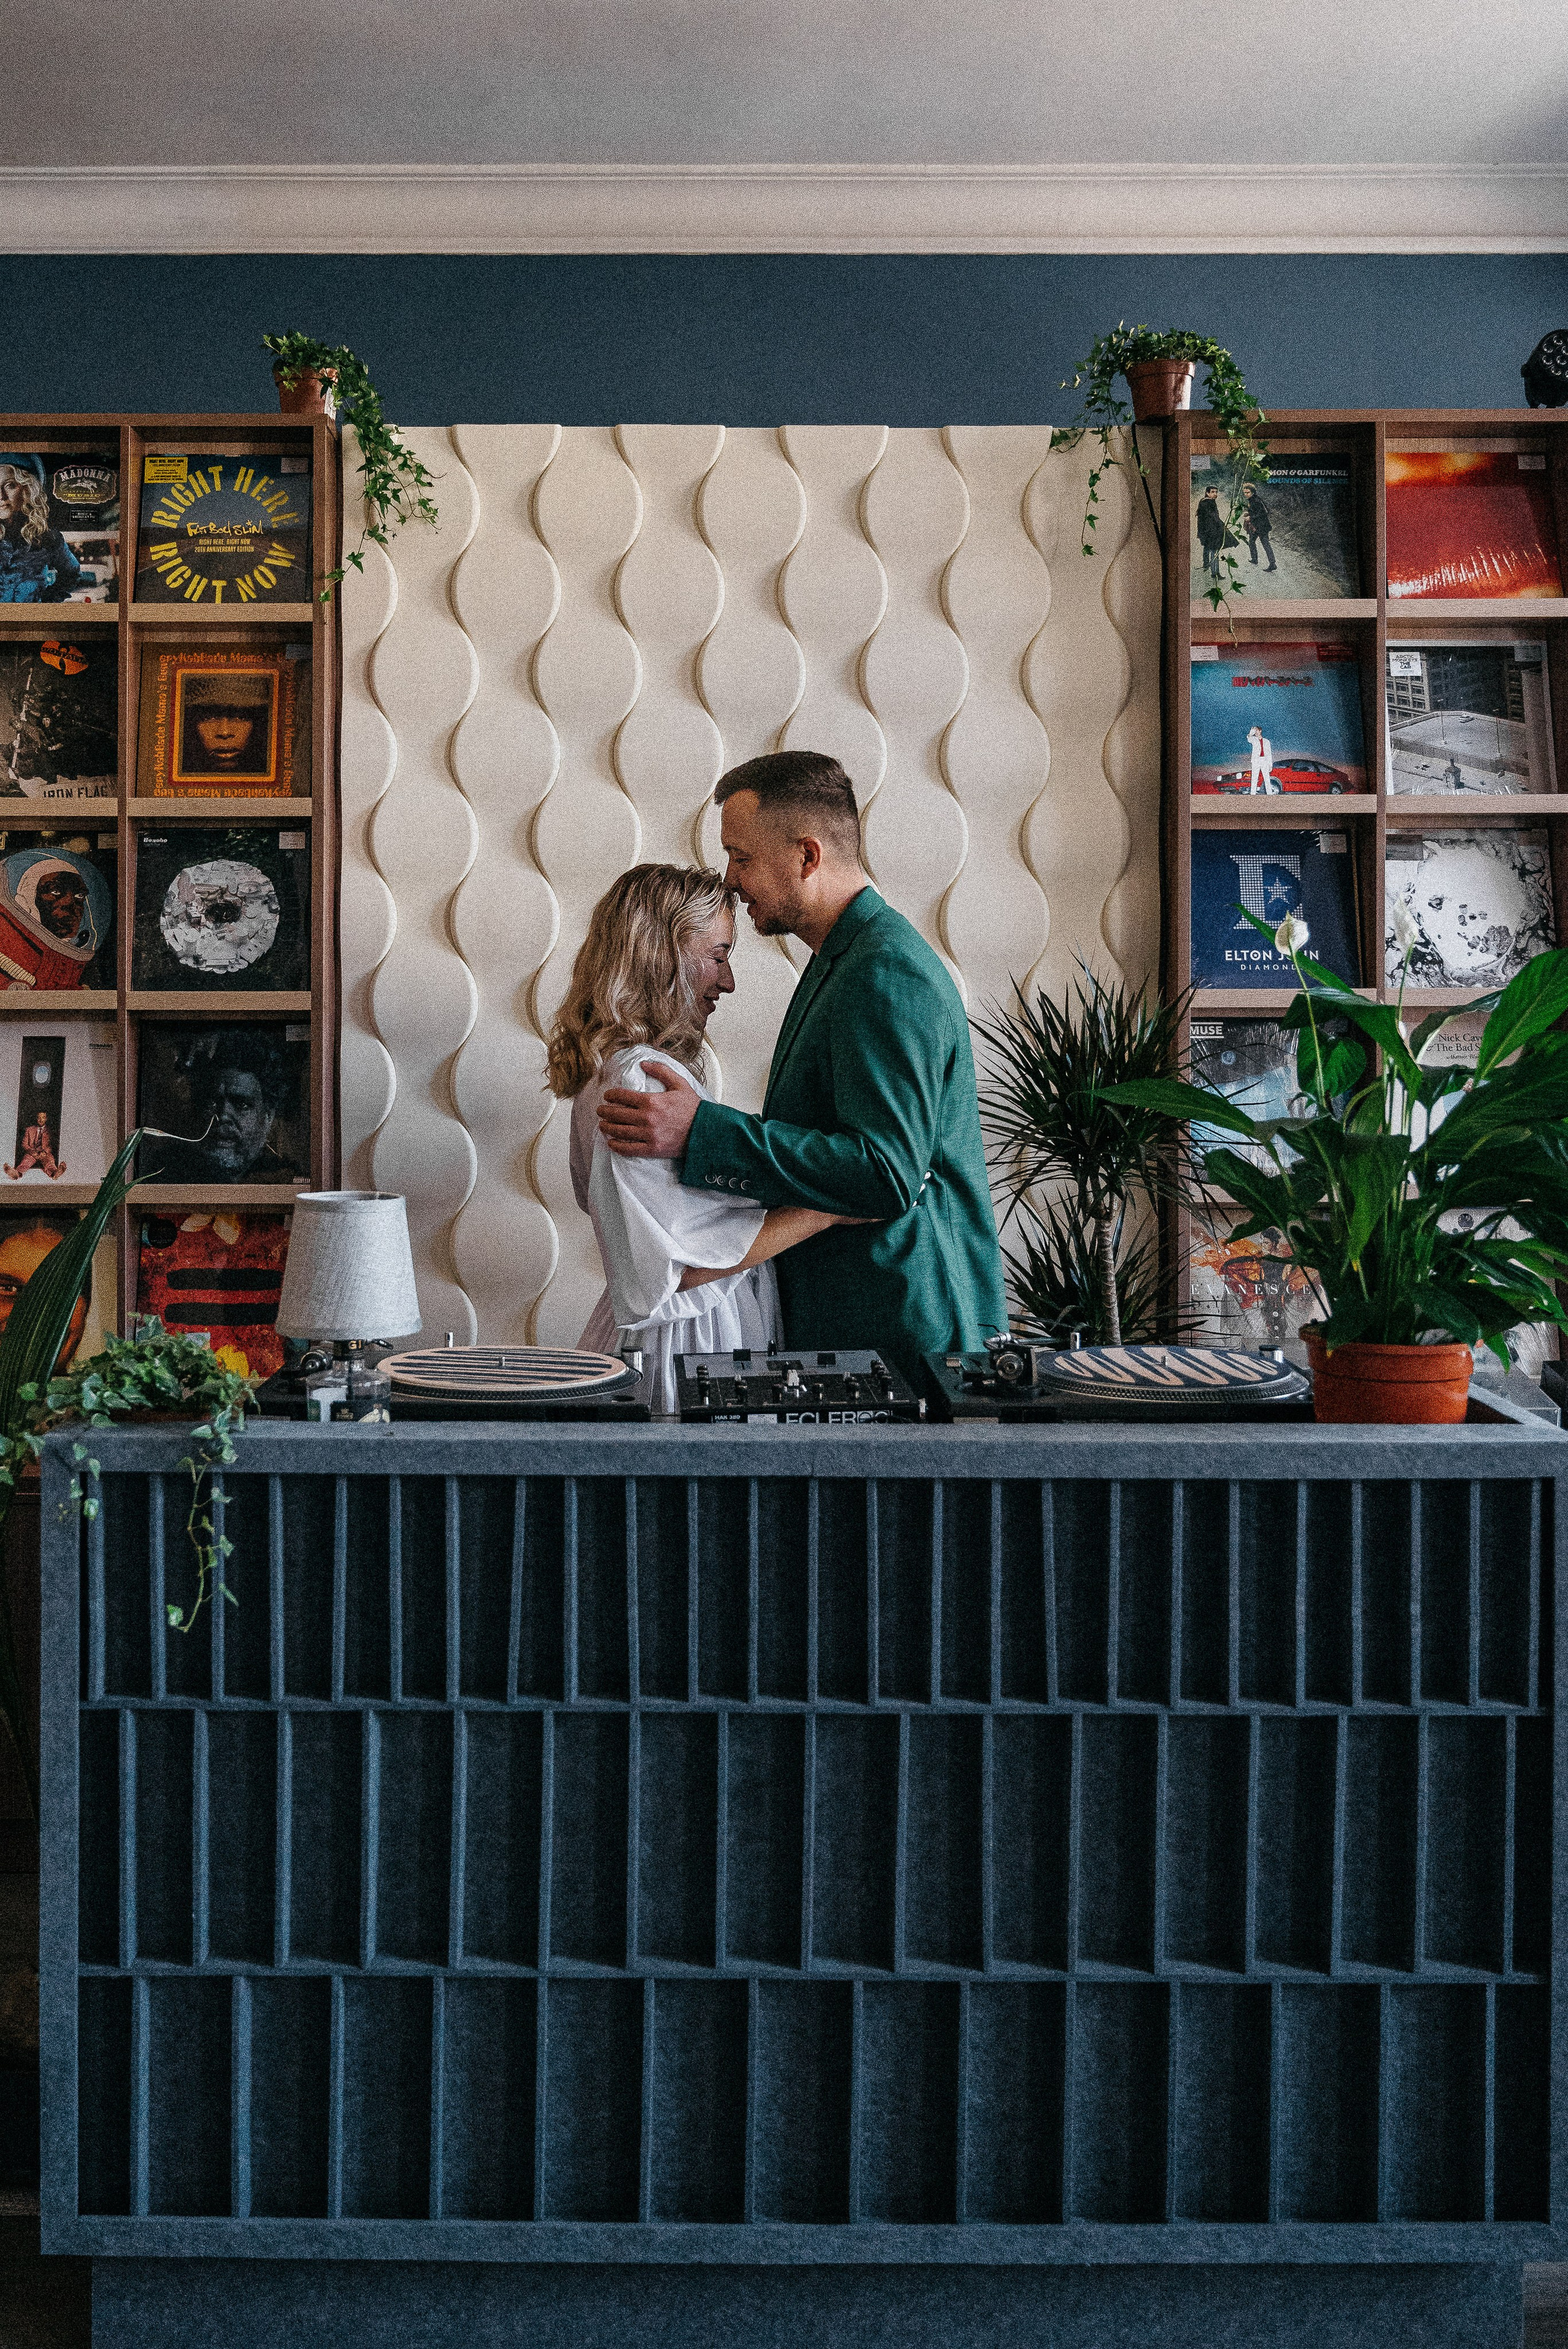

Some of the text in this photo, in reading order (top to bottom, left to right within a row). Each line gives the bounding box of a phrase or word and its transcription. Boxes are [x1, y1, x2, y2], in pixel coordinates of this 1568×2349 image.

[59, 469, 111, 483] MADONNA
[151, 466, 222, 529] RIGHT
[150, 542, 295, 603] RIGHT NOW
[1225, 951, 1319, 960] ELTON JN
[1190, 1026, 1223, 1035] MUSE
[1438, 1033, 1460, 1042] Nick
[1434, 1043, 1453, 1052] The
[1455, 1043, 1472, 1052] Bad
[1191, 1284, 1325, 1295] EVANESCE
